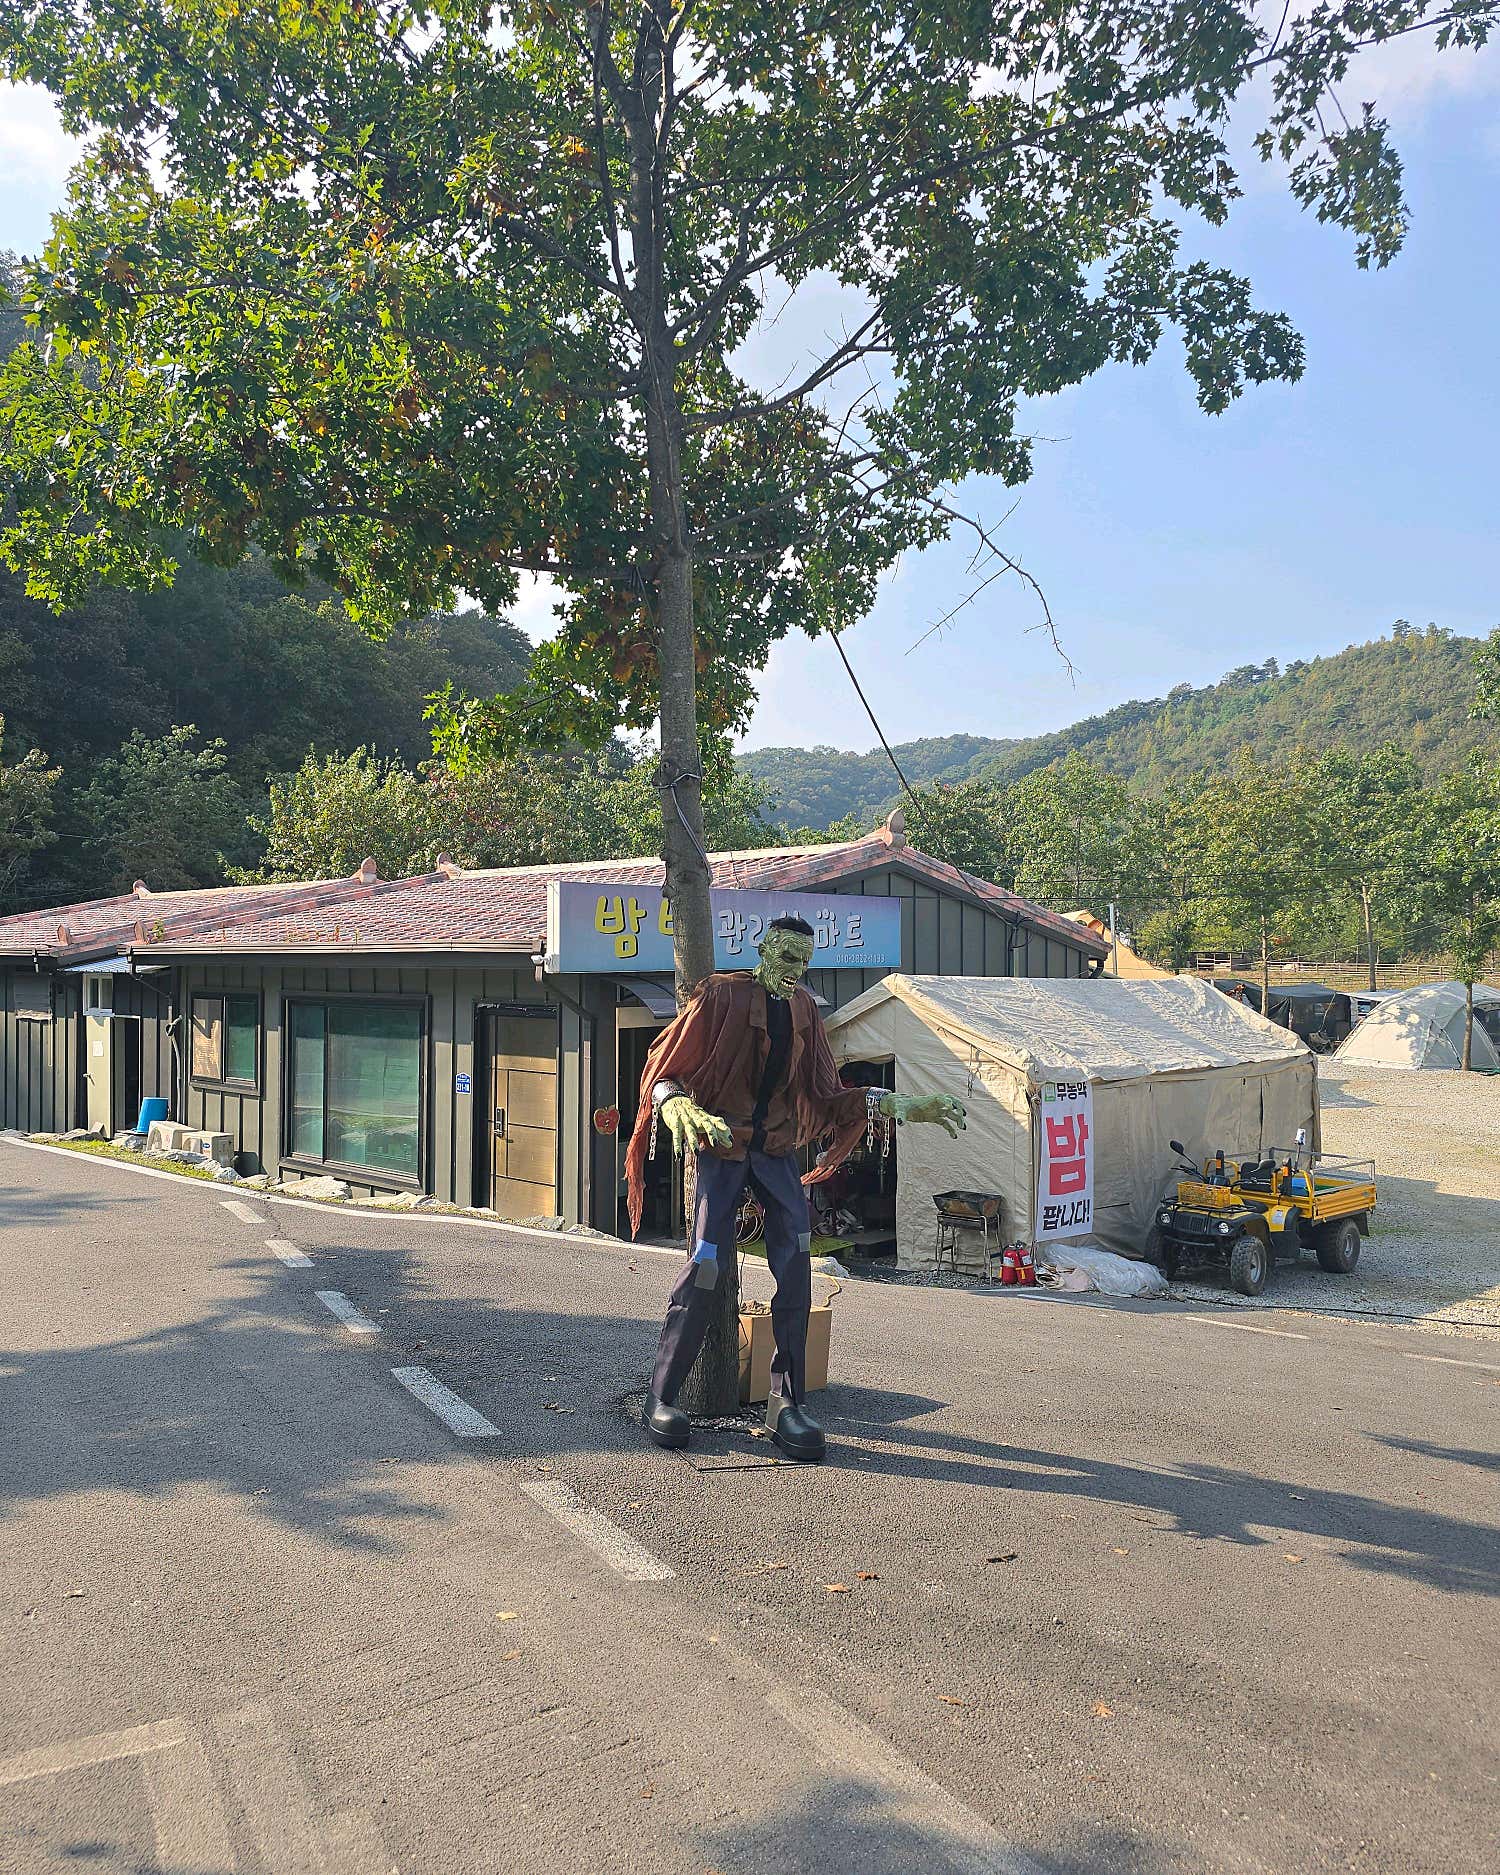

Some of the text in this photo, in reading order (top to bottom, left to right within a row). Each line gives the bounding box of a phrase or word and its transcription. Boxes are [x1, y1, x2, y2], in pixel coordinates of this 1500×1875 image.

[813, 914, 864, 948] 마트
[1057, 1081, 1087, 1101] 무농약
[1046, 1114, 1088, 1195] 밤
[1043, 1199, 1090, 1230] 팝니다!
